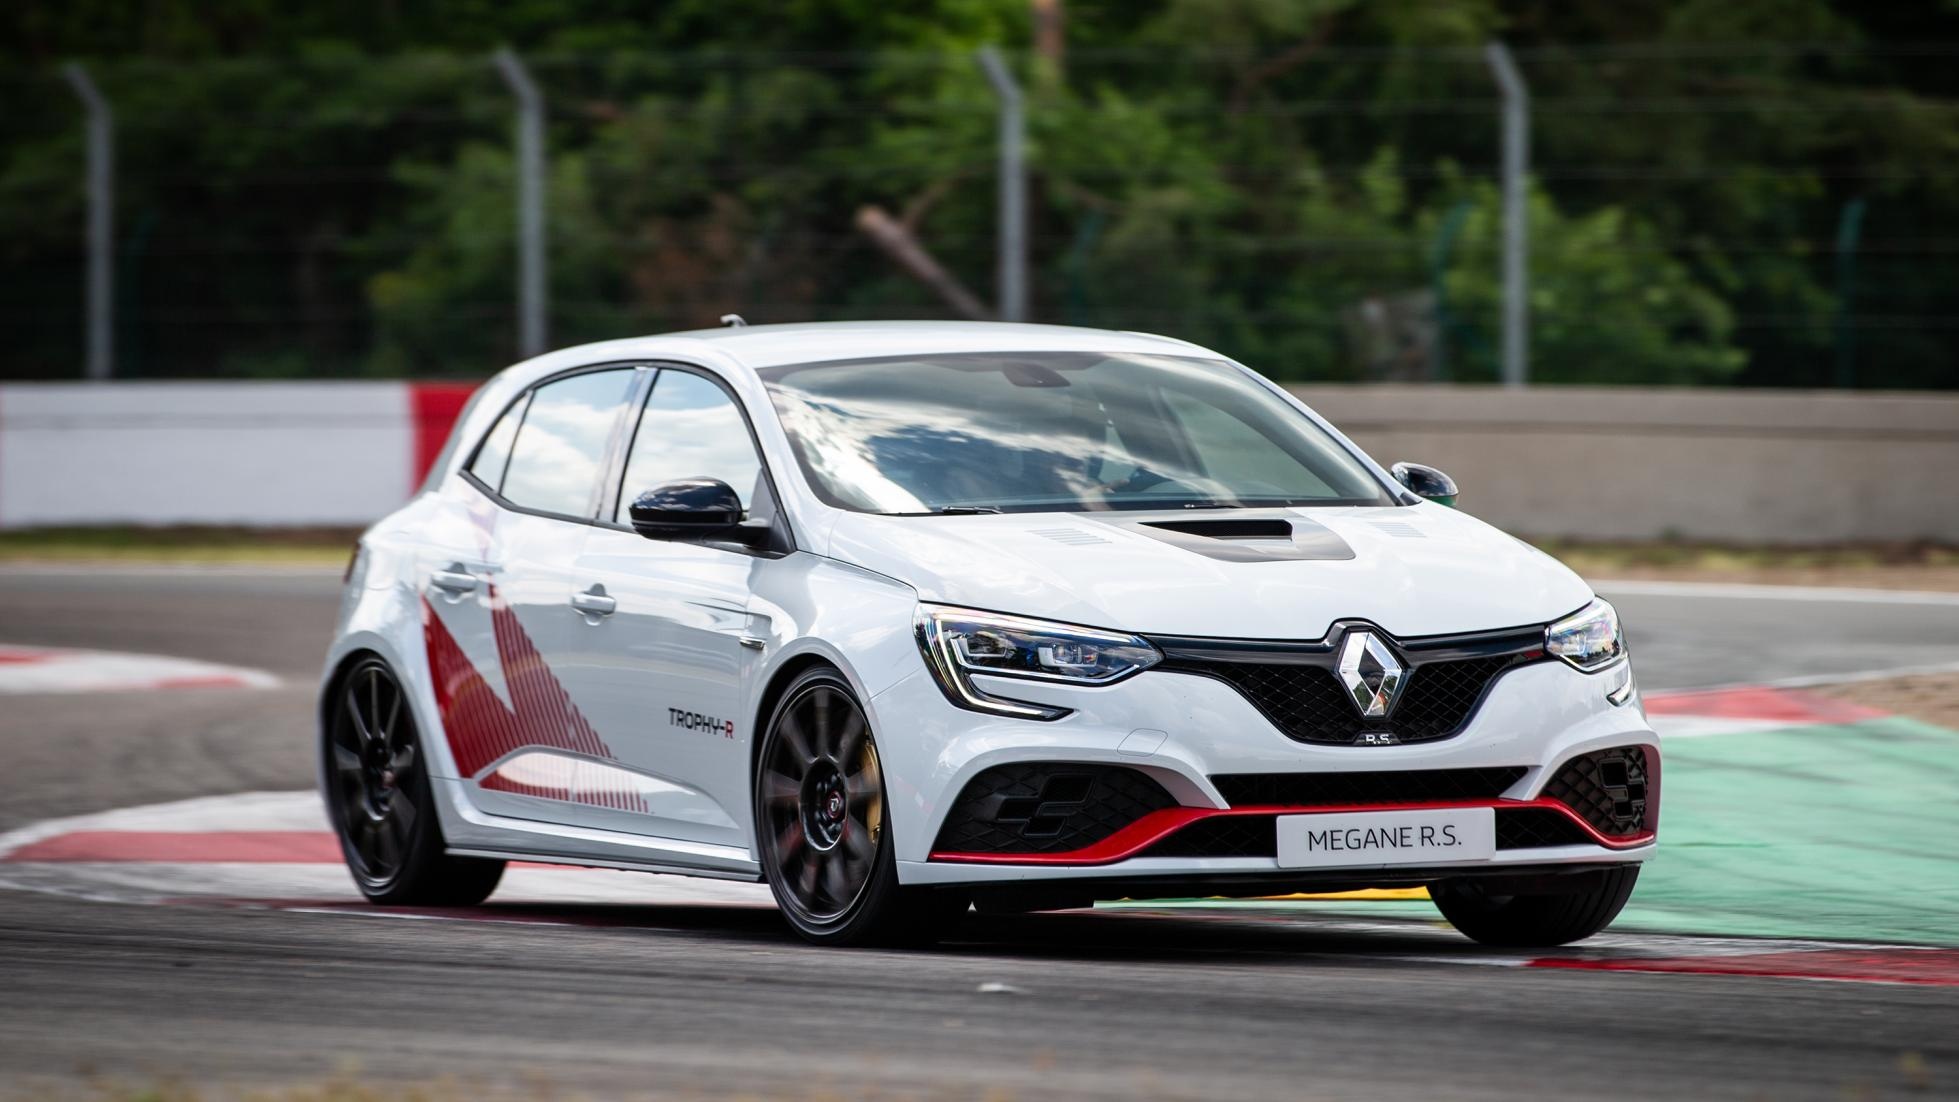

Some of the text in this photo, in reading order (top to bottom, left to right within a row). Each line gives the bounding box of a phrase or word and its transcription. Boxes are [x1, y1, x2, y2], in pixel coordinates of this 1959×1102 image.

[668, 707, 734, 739] TROPHY-R
[1308, 825, 1462, 851] MEGANE R.S.
